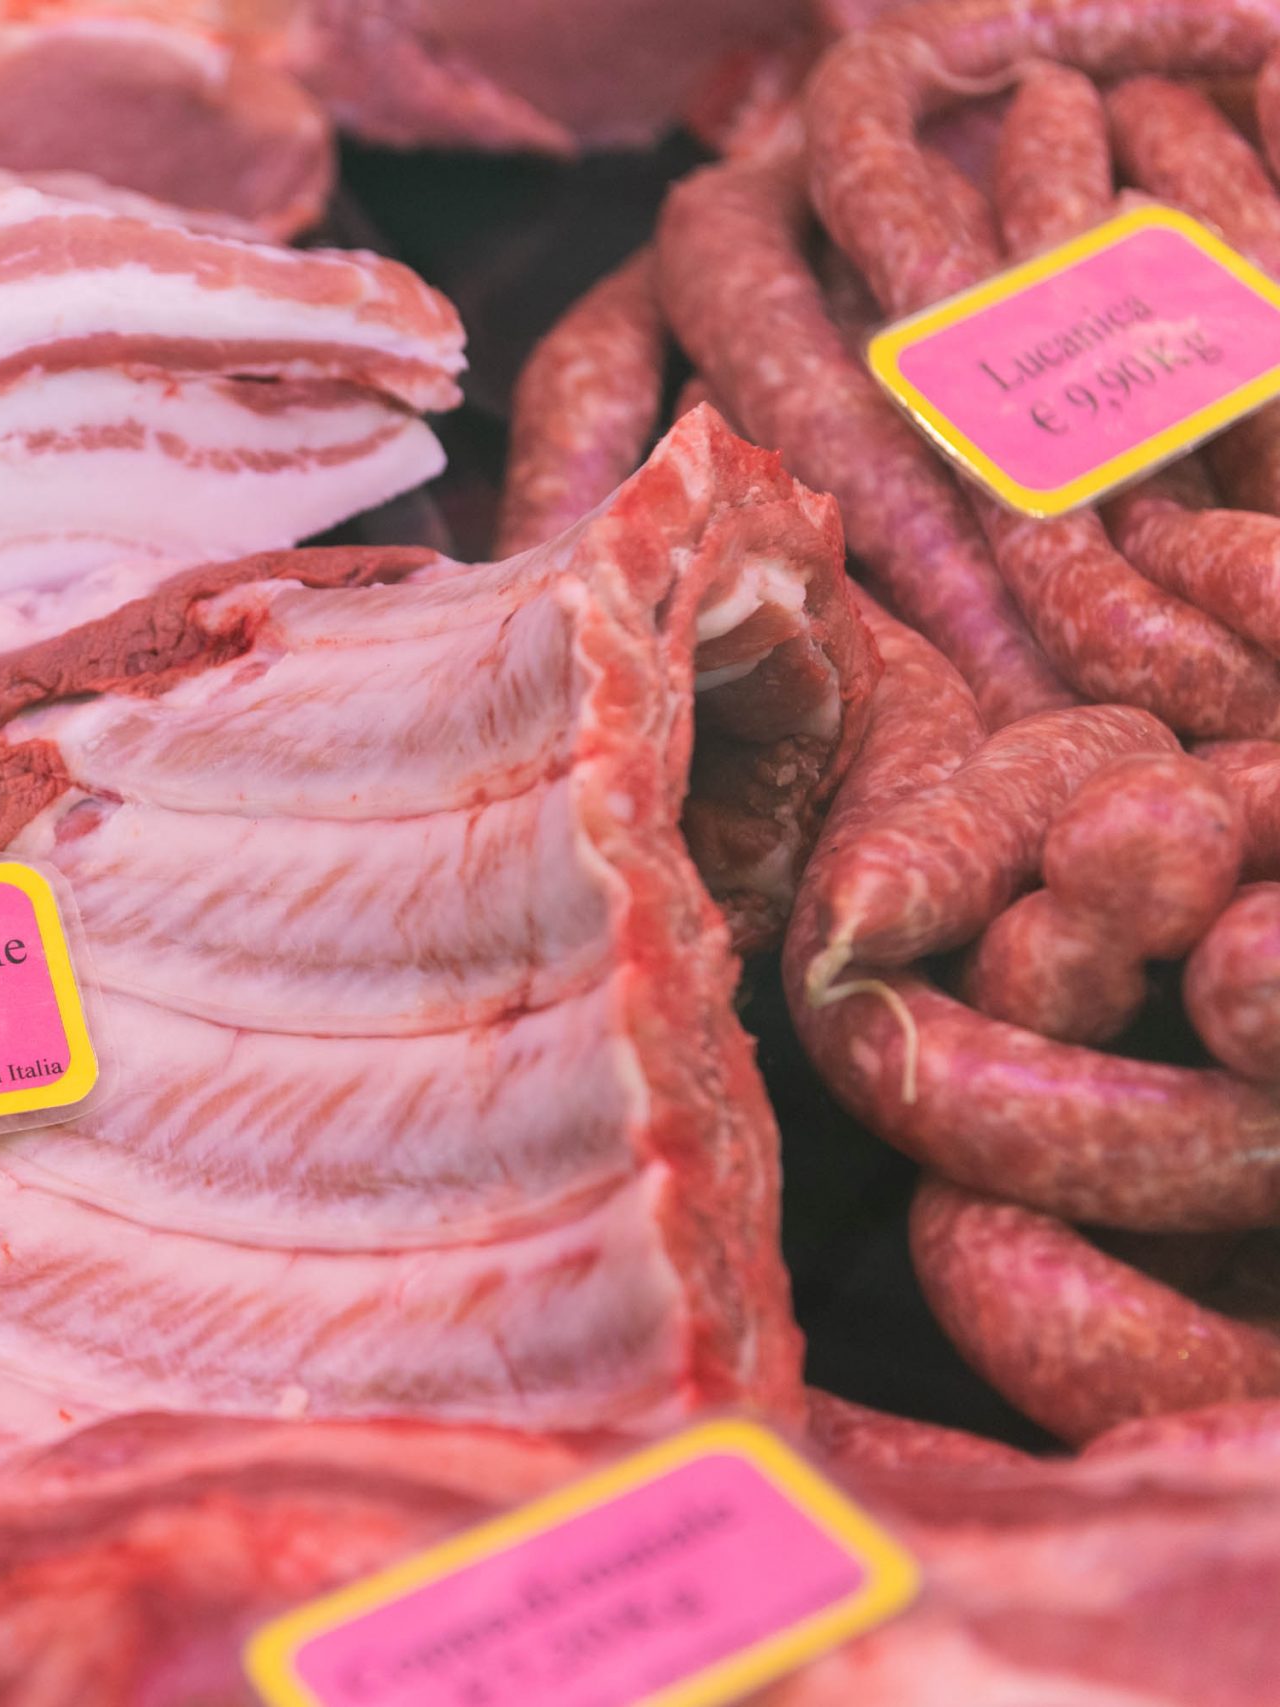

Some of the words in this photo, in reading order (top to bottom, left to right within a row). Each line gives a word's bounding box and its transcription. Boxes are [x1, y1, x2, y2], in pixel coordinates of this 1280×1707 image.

[978, 294, 1152, 392] Lucanica
[1029, 404, 1068, 436] €
[1063, 354, 1158, 416] 9,90
[7, 1058, 64, 1082] Italia
